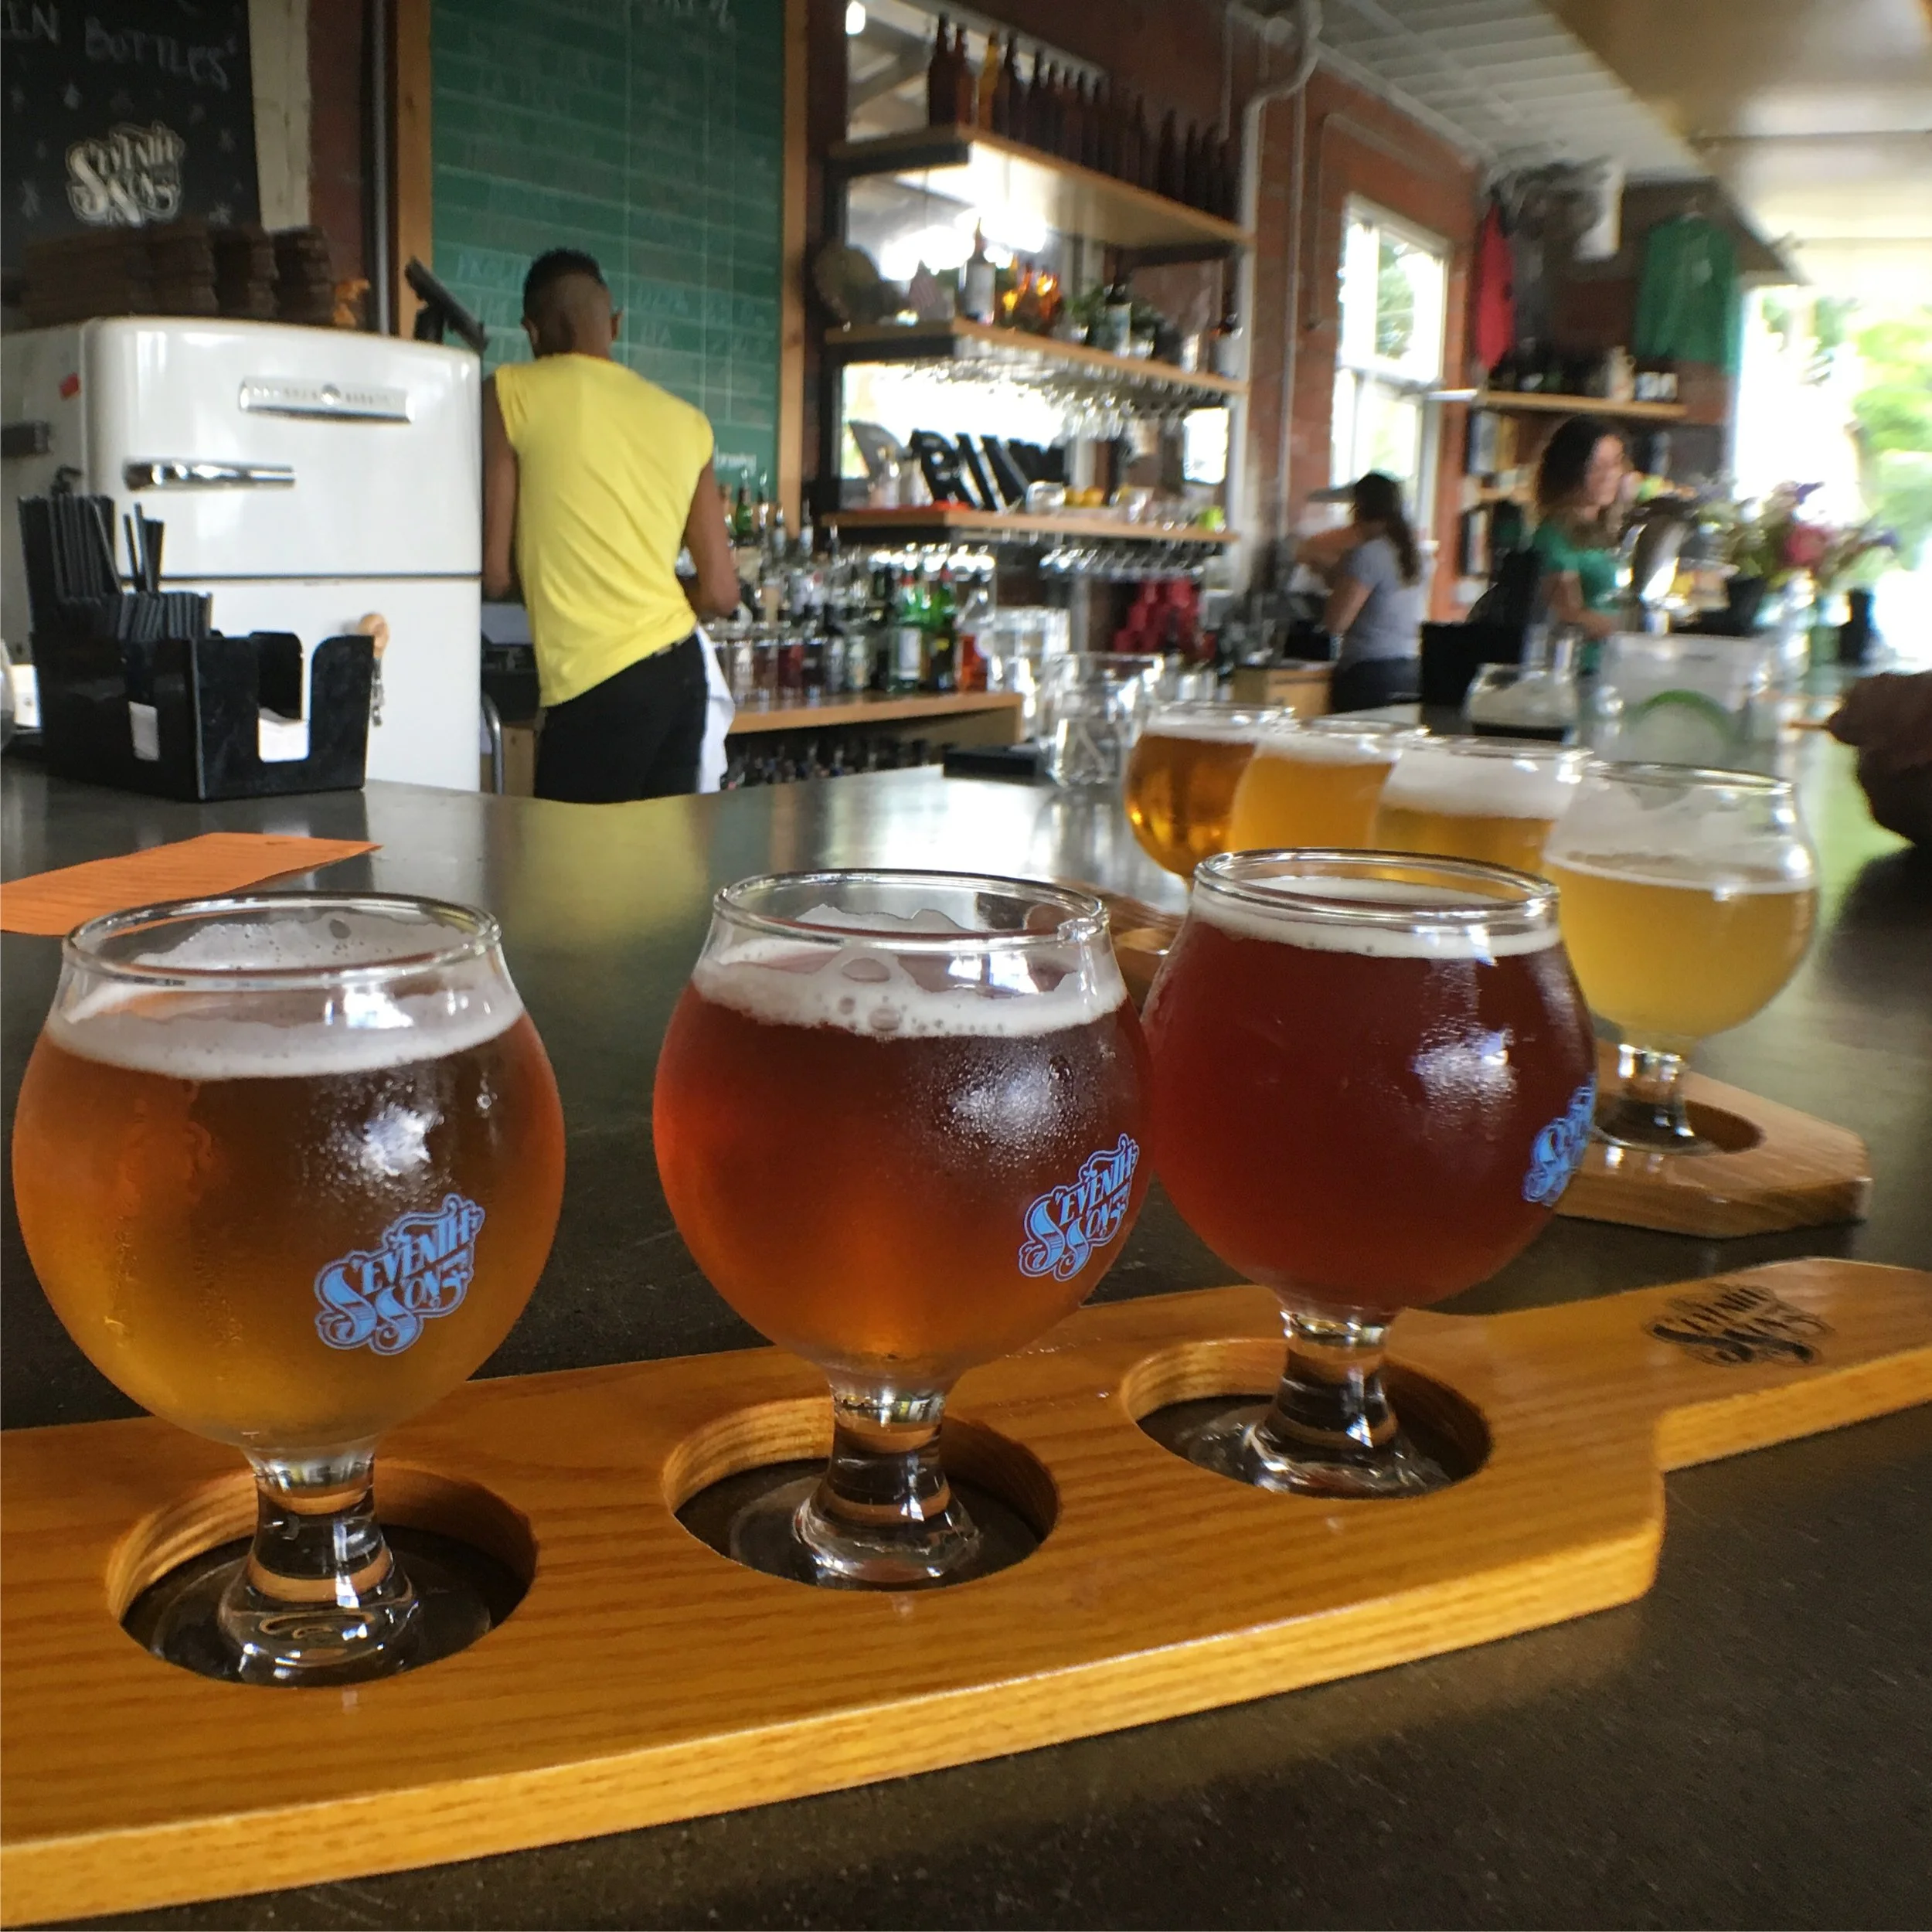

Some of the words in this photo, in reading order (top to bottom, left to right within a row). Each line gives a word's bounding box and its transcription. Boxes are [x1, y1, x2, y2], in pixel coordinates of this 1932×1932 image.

[1019, 1134, 1140, 1277] SEVENTH
[1053, 1183, 1129, 1281] SONS
[314, 1193, 485, 1349] SEVENTH
[368, 1247, 474, 1355] SONS
